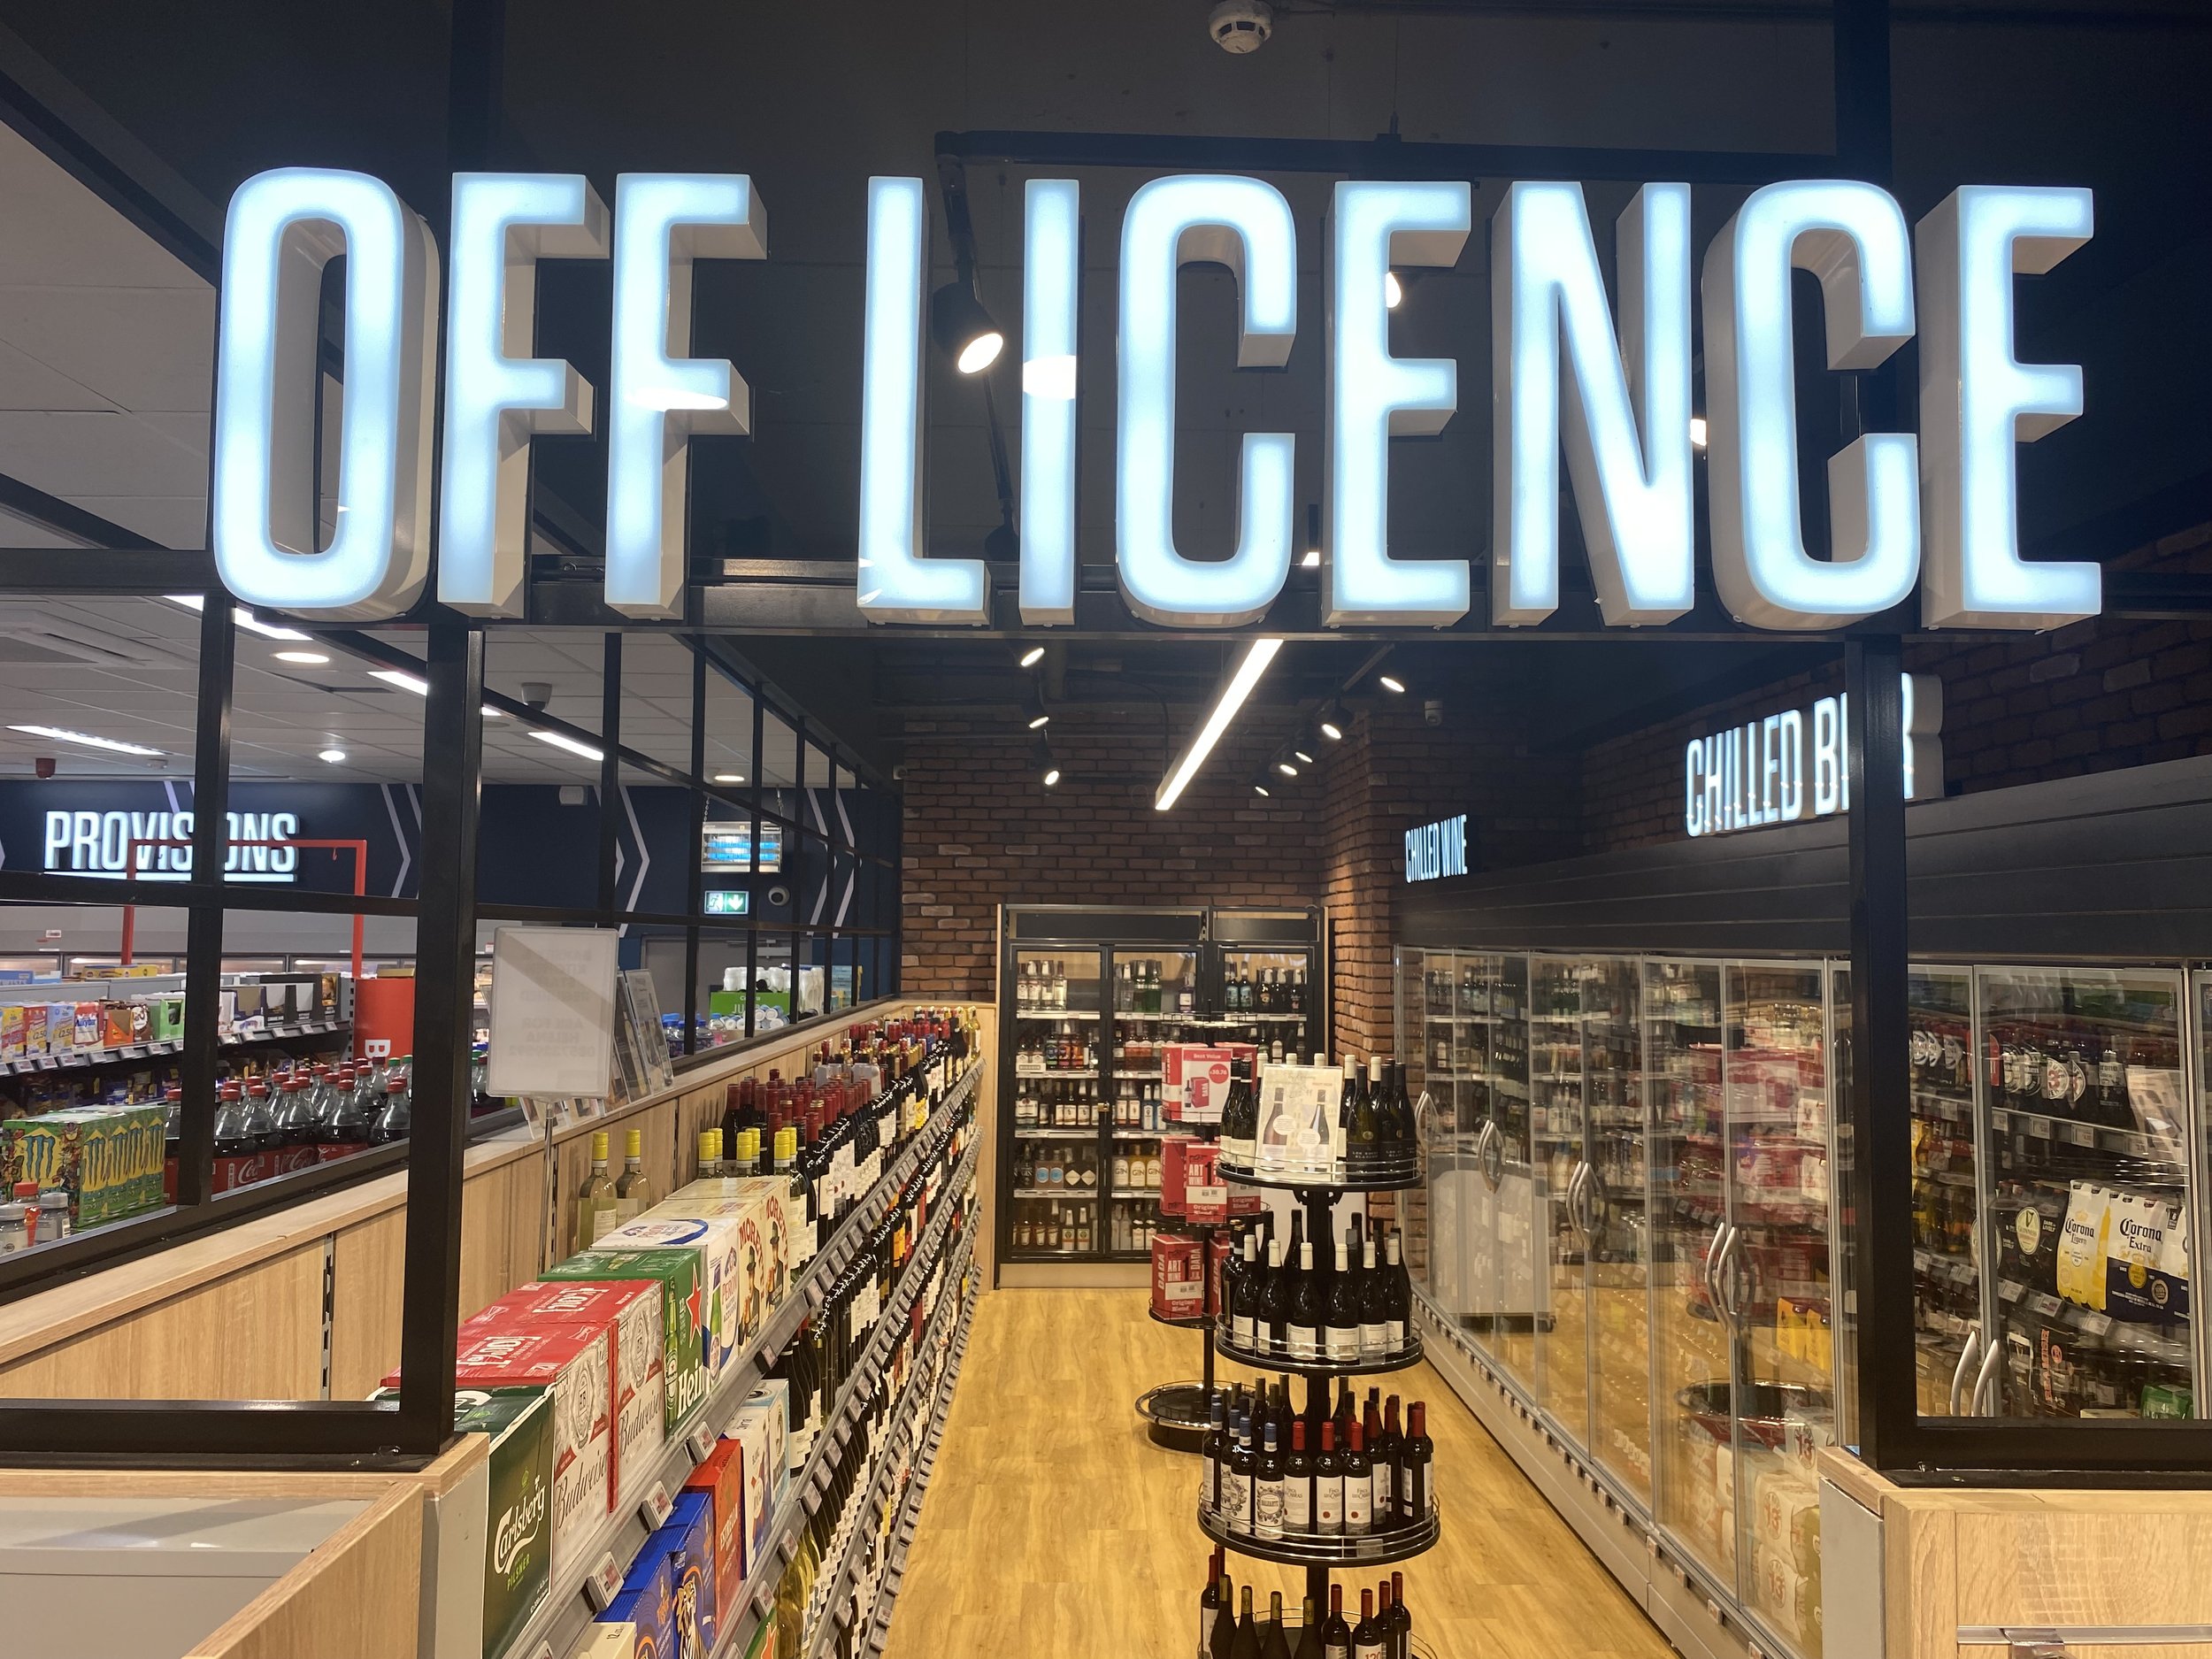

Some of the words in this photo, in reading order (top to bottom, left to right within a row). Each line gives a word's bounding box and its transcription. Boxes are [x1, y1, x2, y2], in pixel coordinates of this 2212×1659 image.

[212, 165, 757, 611] OFF
[856, 173, 2102, 618] LICENCE
[1686, 709, 1802, 837] CHILLED
[43, 810, 297, 872] PROVISONS
[1405, 821, 1440, 884] CHILLED
[1440, 813, 1469, 878] WINE
[2065, 1217, 2095, 1238] Corona
[2119, 1217, 2162, 1242] Corona
[2129, 1236, 2152, 1253] Extra
[619, 1388, 663, 1459] Budweiser
[555, 1448, 609, 1533] Budweiser
[494, 1483, 547, 1576] Carlsberg
[506, 1553, 531, 1592] PILSNER
